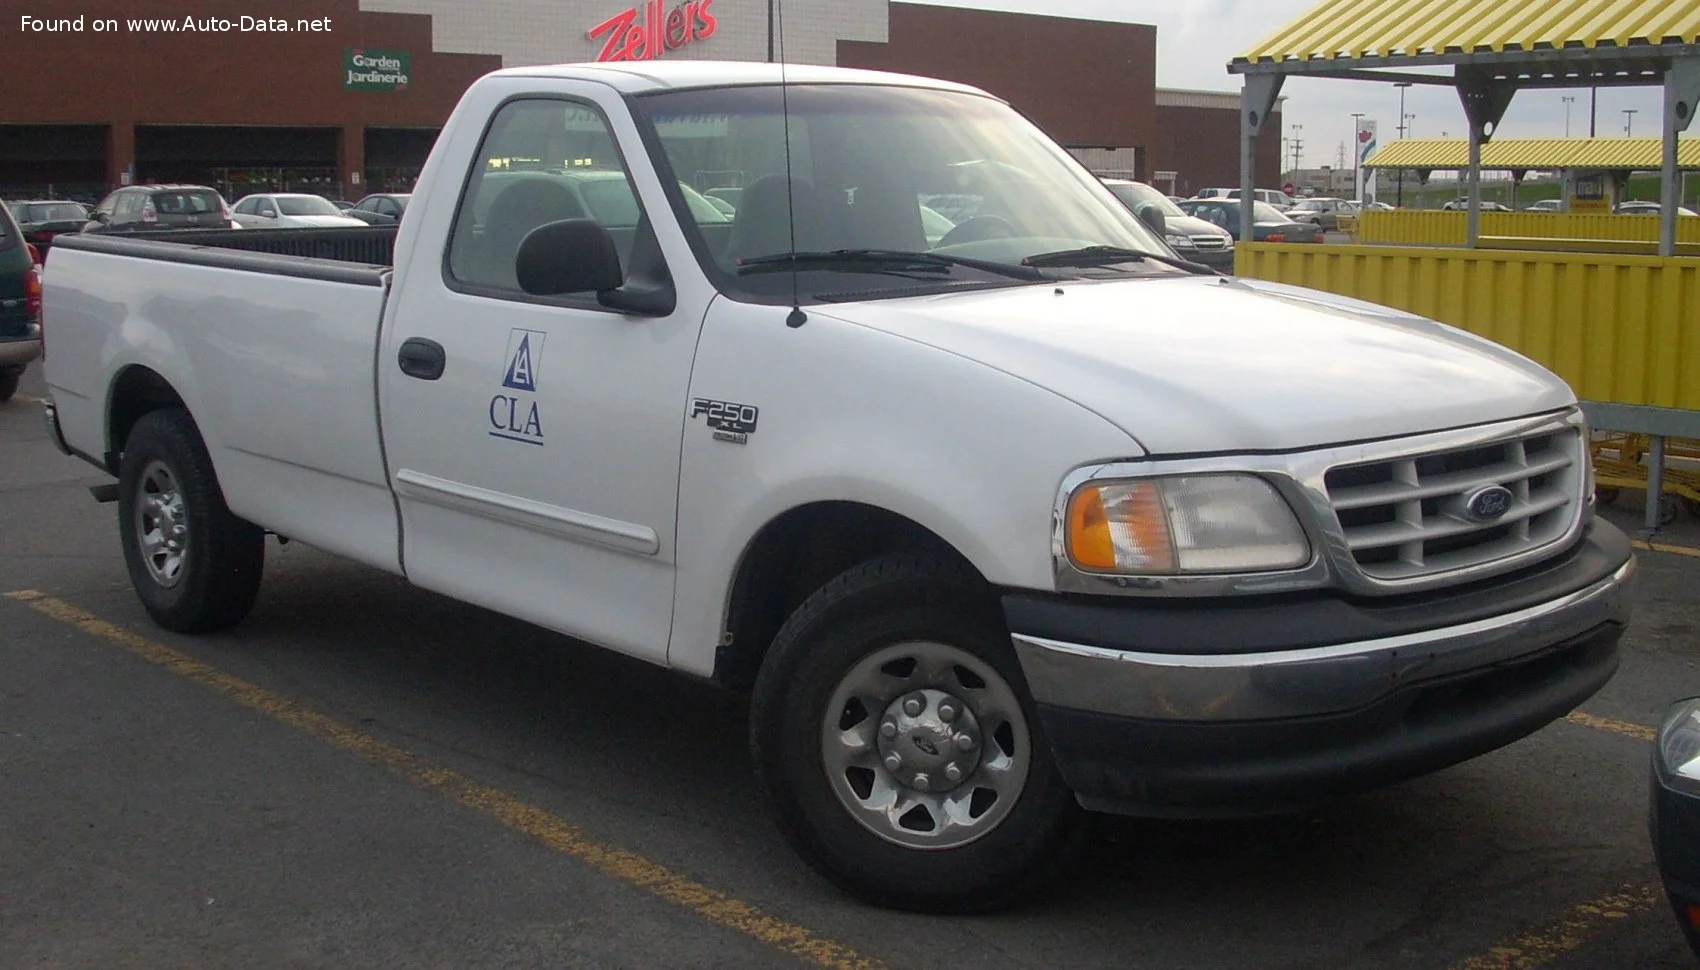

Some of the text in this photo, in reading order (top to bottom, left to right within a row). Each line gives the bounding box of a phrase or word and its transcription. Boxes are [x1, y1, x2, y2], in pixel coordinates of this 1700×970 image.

[588, 0, 717, 62] Zellers
[353, 55, 400, 68] Garden
[347, 70, 408, 85] Jardinerie
[490, 395, 543, 437] CLA
[721, 421, 742, 429] XL
